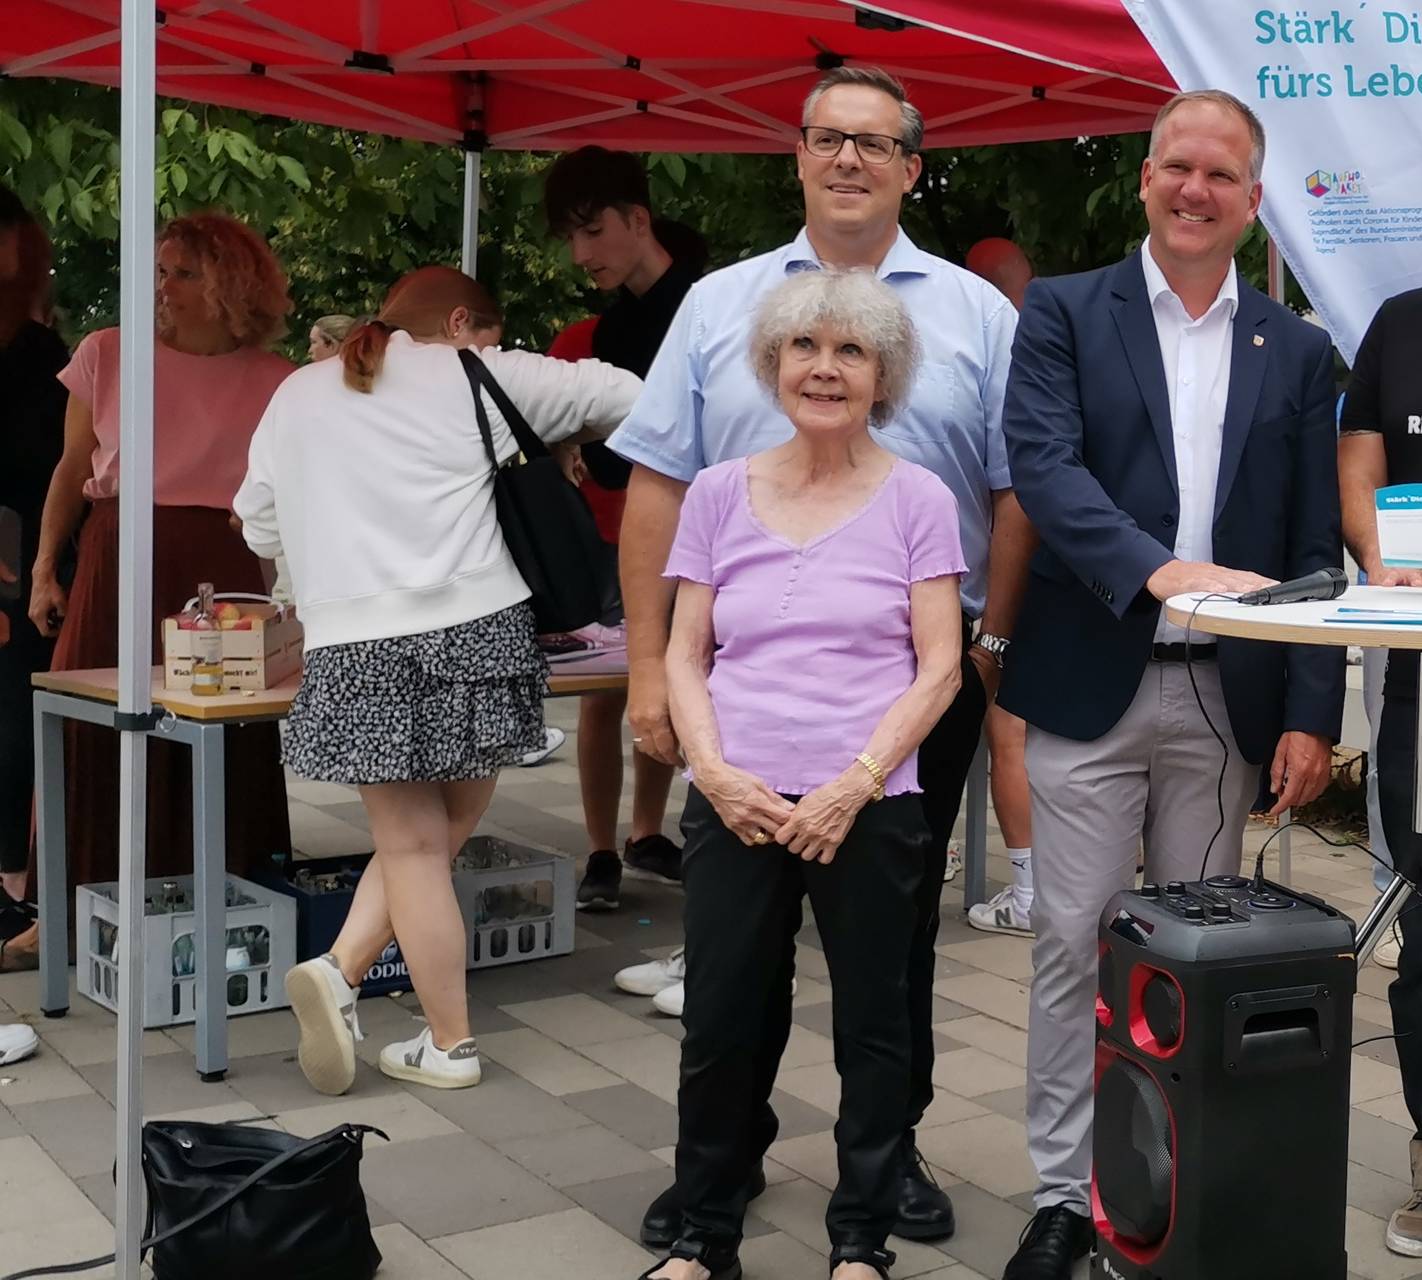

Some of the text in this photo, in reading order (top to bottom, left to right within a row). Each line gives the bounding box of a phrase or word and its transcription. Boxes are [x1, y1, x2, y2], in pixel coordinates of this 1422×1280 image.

[1257, 65, 1333, 99] fürs
[1363, 217, 1389, 225] Corona
[363, 961, 409, 980] ODIU
